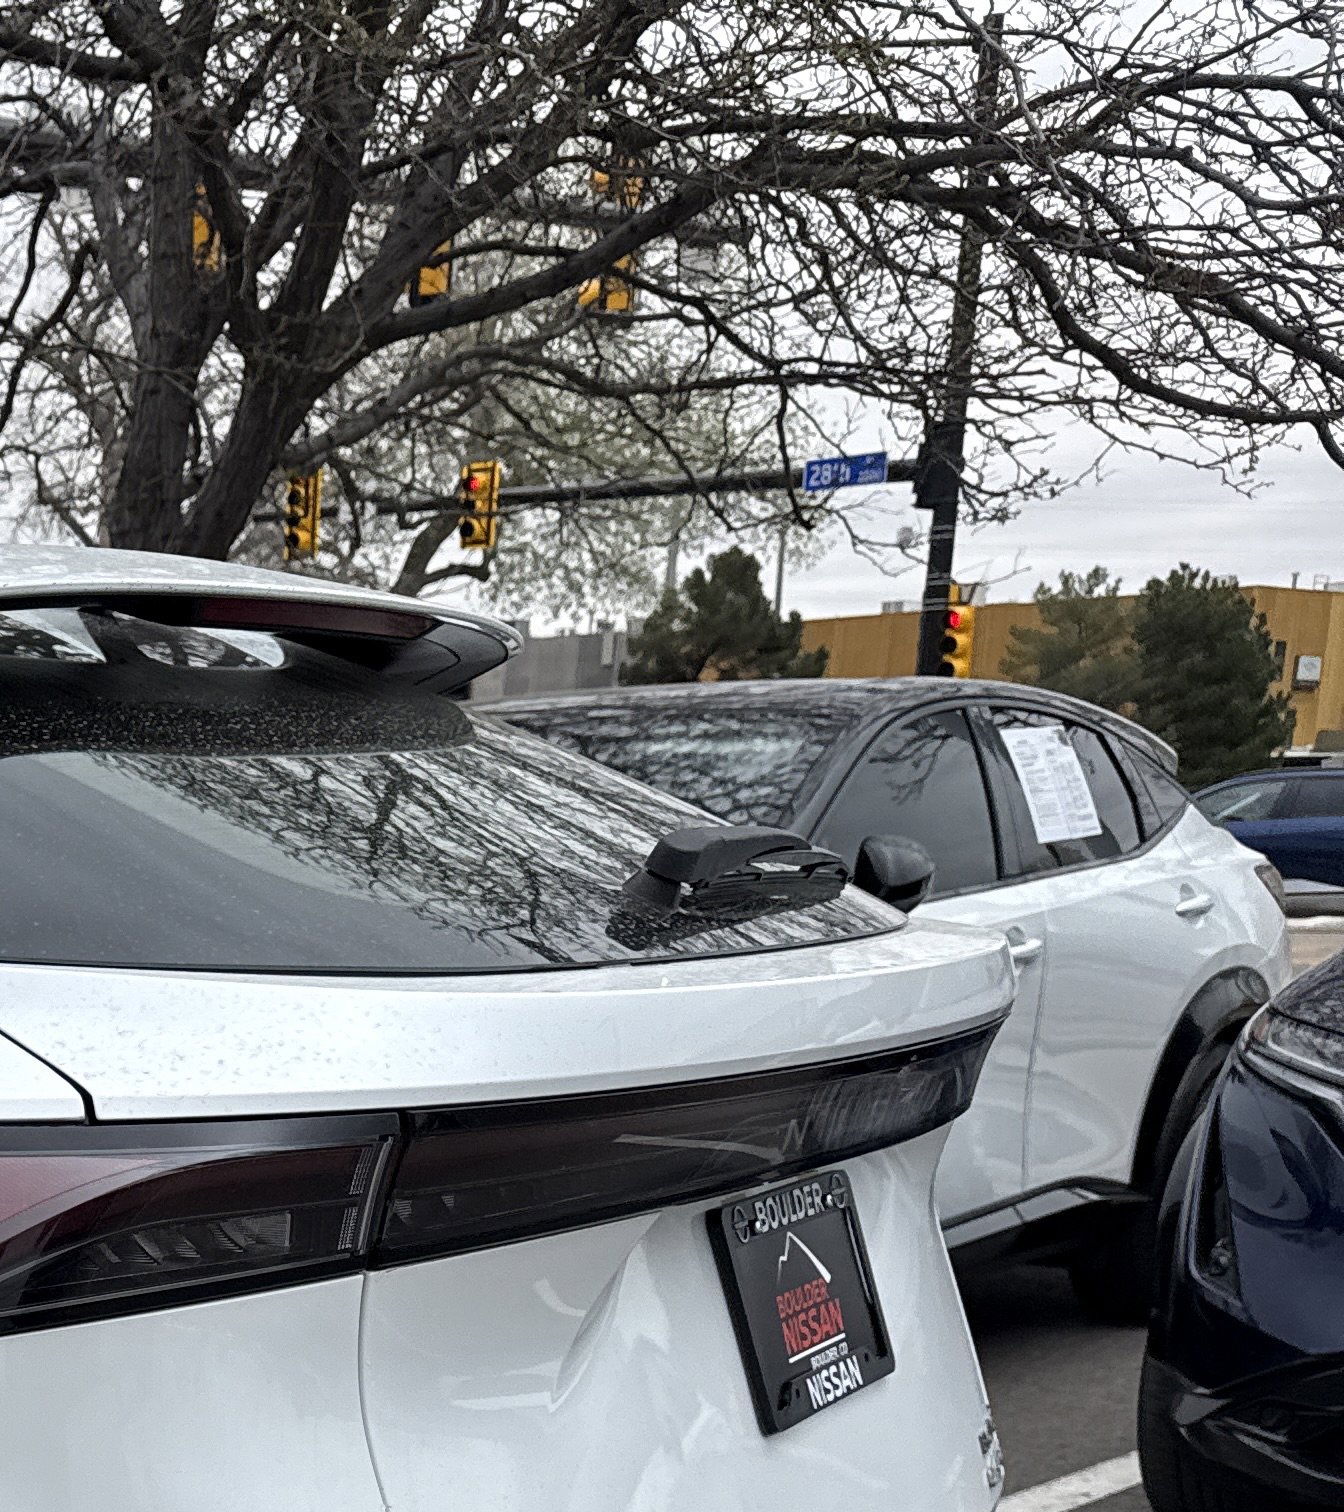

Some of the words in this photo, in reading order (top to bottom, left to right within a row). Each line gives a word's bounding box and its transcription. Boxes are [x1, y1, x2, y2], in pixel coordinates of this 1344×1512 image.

[754, 1181, 825, 1233] BOULDER
[775, 1276, 830, 1319] BOULDER
[781, 1298, 844, 1356] NISSAN
[806, 1355, 863, 1410] NISSAN
